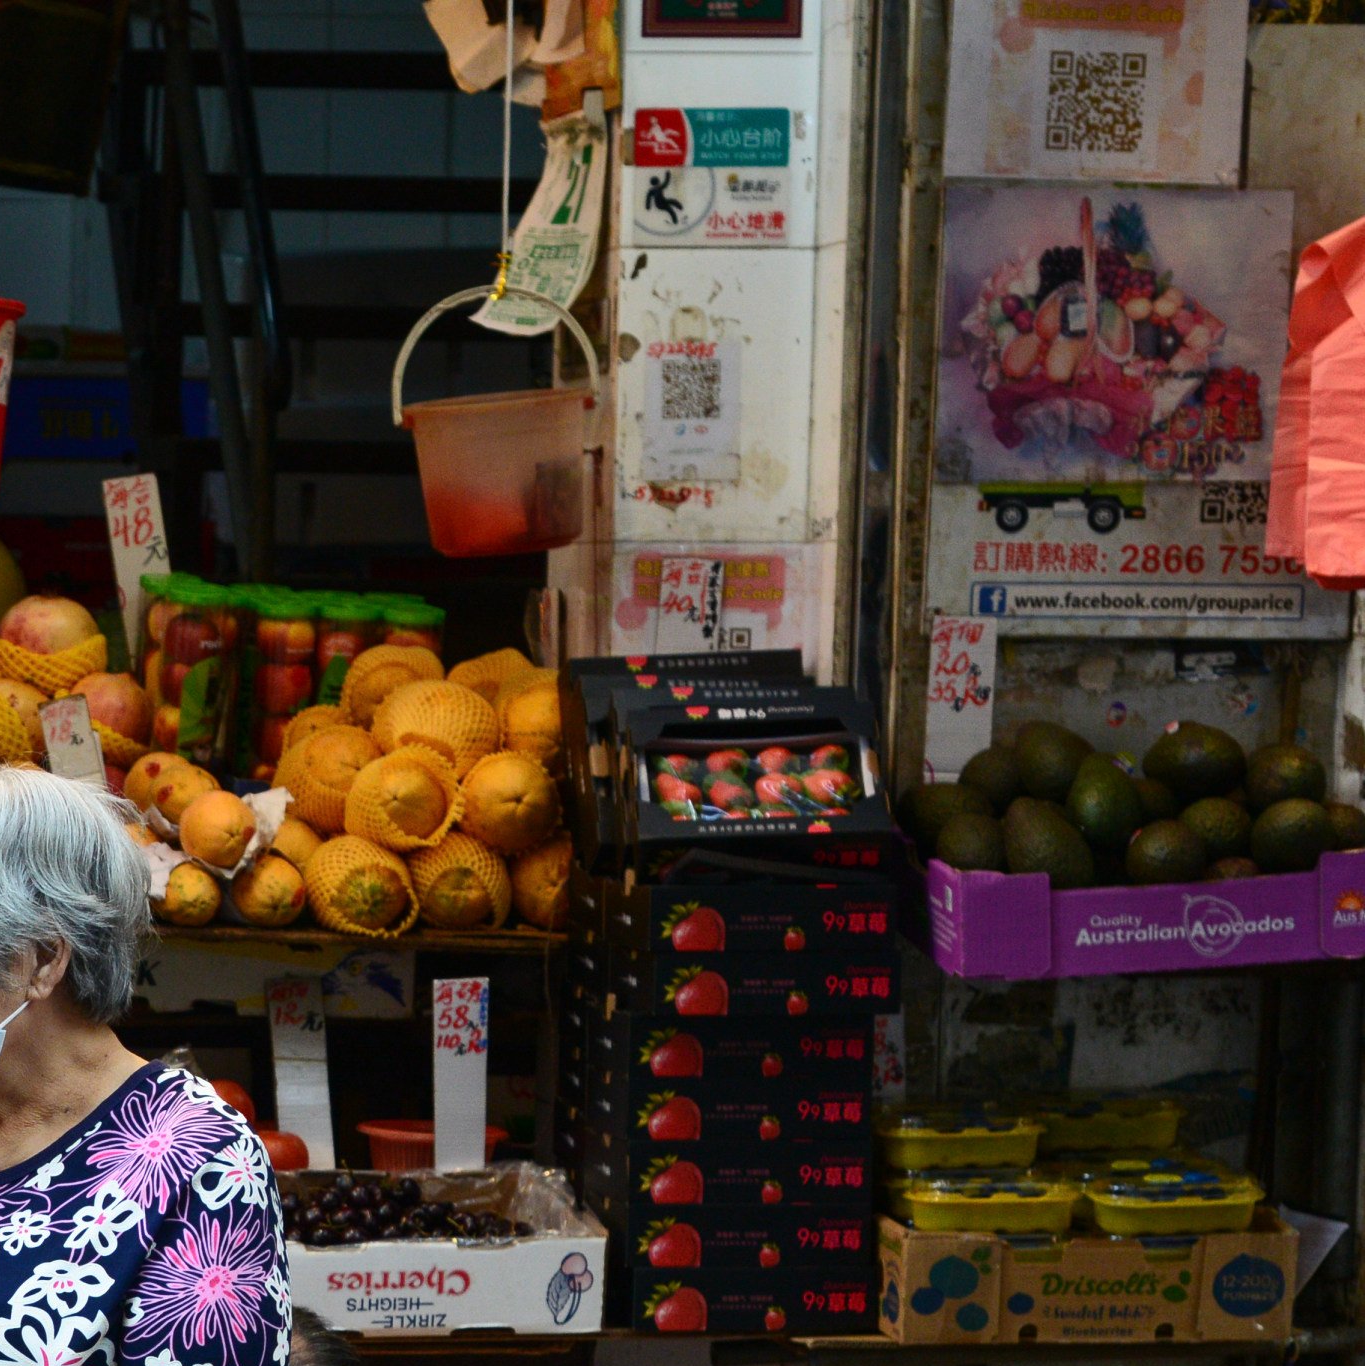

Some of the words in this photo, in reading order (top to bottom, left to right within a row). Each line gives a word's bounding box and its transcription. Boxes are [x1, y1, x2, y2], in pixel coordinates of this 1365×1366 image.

[700, 126, 784, 149] 小心台阶
[705, 210, 787, 231] 小心地滑
[973, 541, 1109, 575] 訂購熱線:
[1120, 546, 1205, 574] 2866
[1014, 591, 1295, 616] www.facebook.com/grouparice
[821, 908, 888, 935] 99草莓
[1075, 923, 1186, 948] Australian
[1192, 914, 1296, 940] Avocados
[1090, 914, 1143, 930] Quality
[825, 973, 892, 1000] 99草莓
[799, 1035, 866, 1061] 99草莓
[796, 1099, 863, 1125] 99草莓
[798, 1163, 865, 1189] 99草莓
[796, 1226, 863, 1252] 99草莓
[327, 1264, 472, 1297] Cherries
[1040, 1271, 1161, 1298] Driscoll's
[346, 1296, 420, 1312] HEIGHTS
[801, 1288, 868, 1315] 99草莓
[384, 1313, 447, 1329] ZIRKLE
[1062, 1325, 1135, 1338] Blueberries
